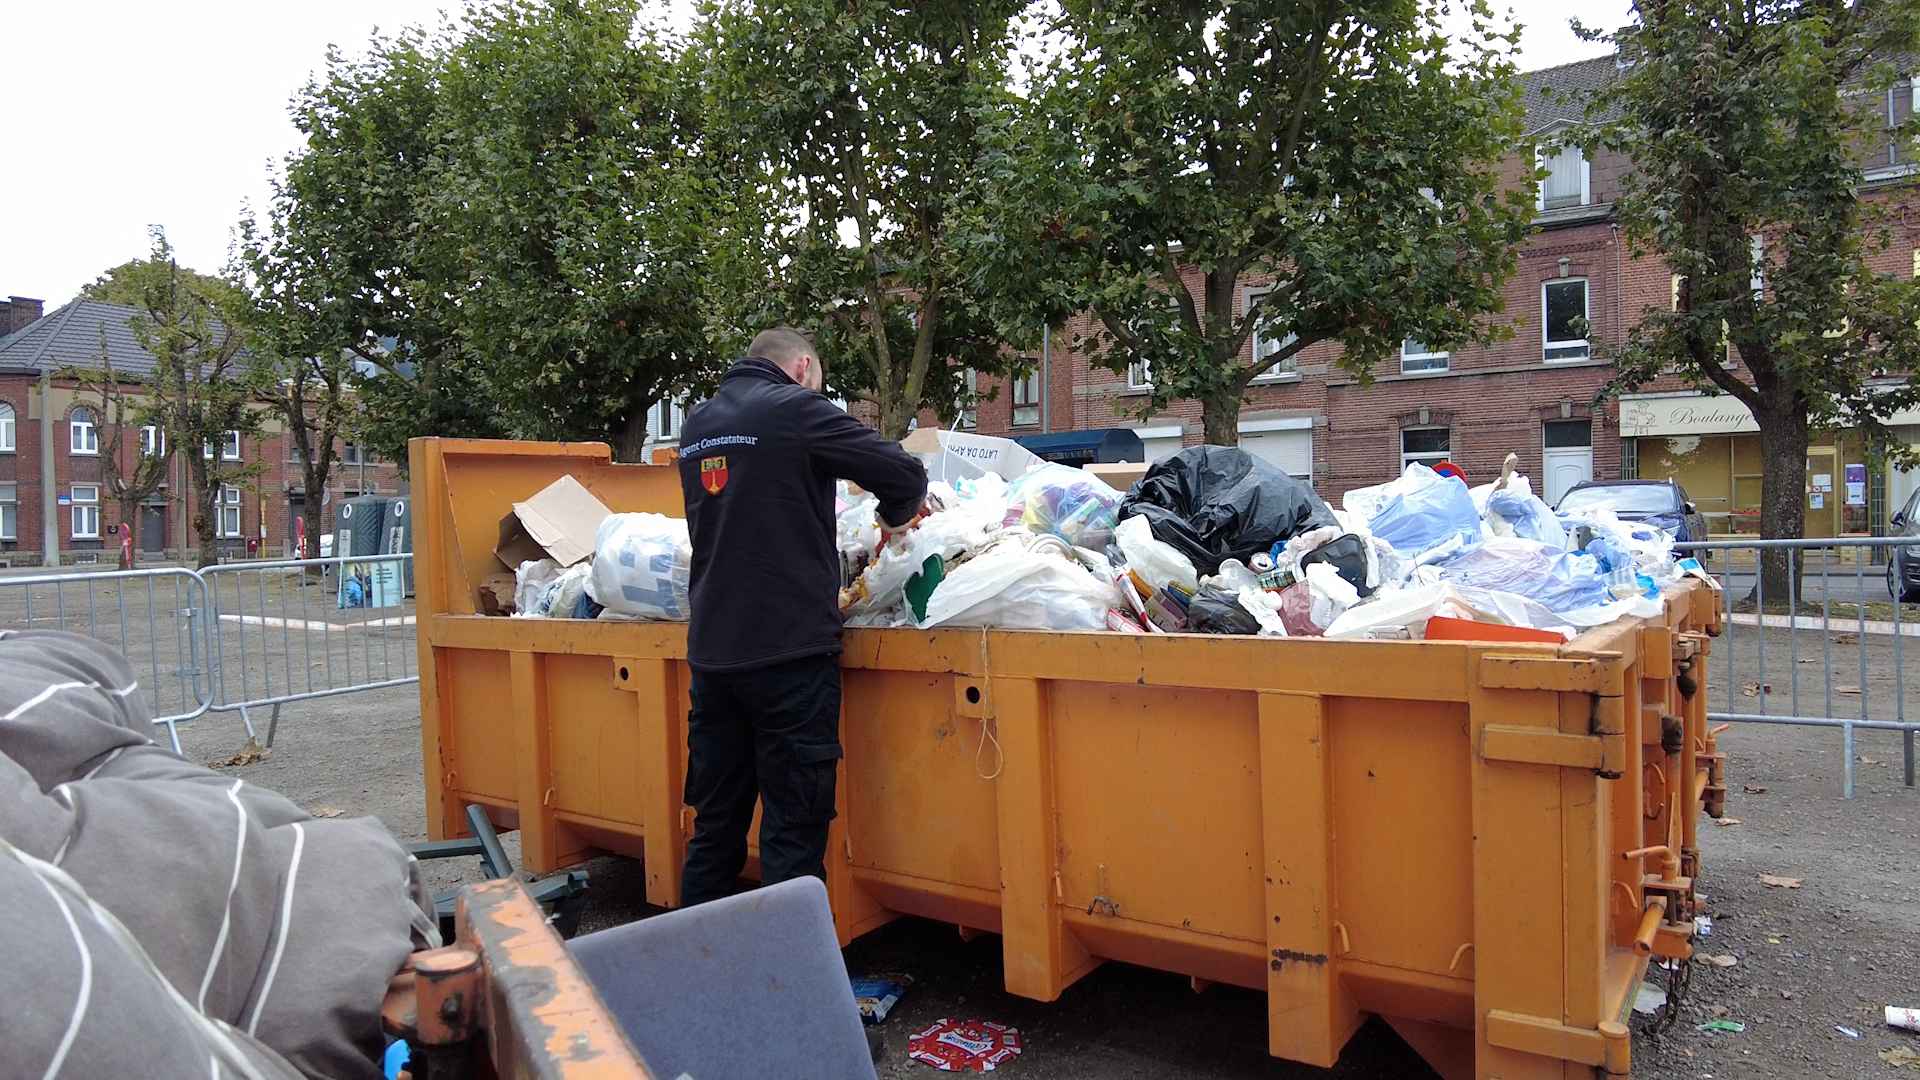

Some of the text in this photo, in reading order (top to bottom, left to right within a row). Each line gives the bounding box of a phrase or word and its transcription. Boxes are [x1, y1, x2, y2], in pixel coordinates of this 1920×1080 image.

[700, 435, 758, 449] Constatateur
[967, 446, 979, 458] DA
[979, 448, 999, 460] LATO
